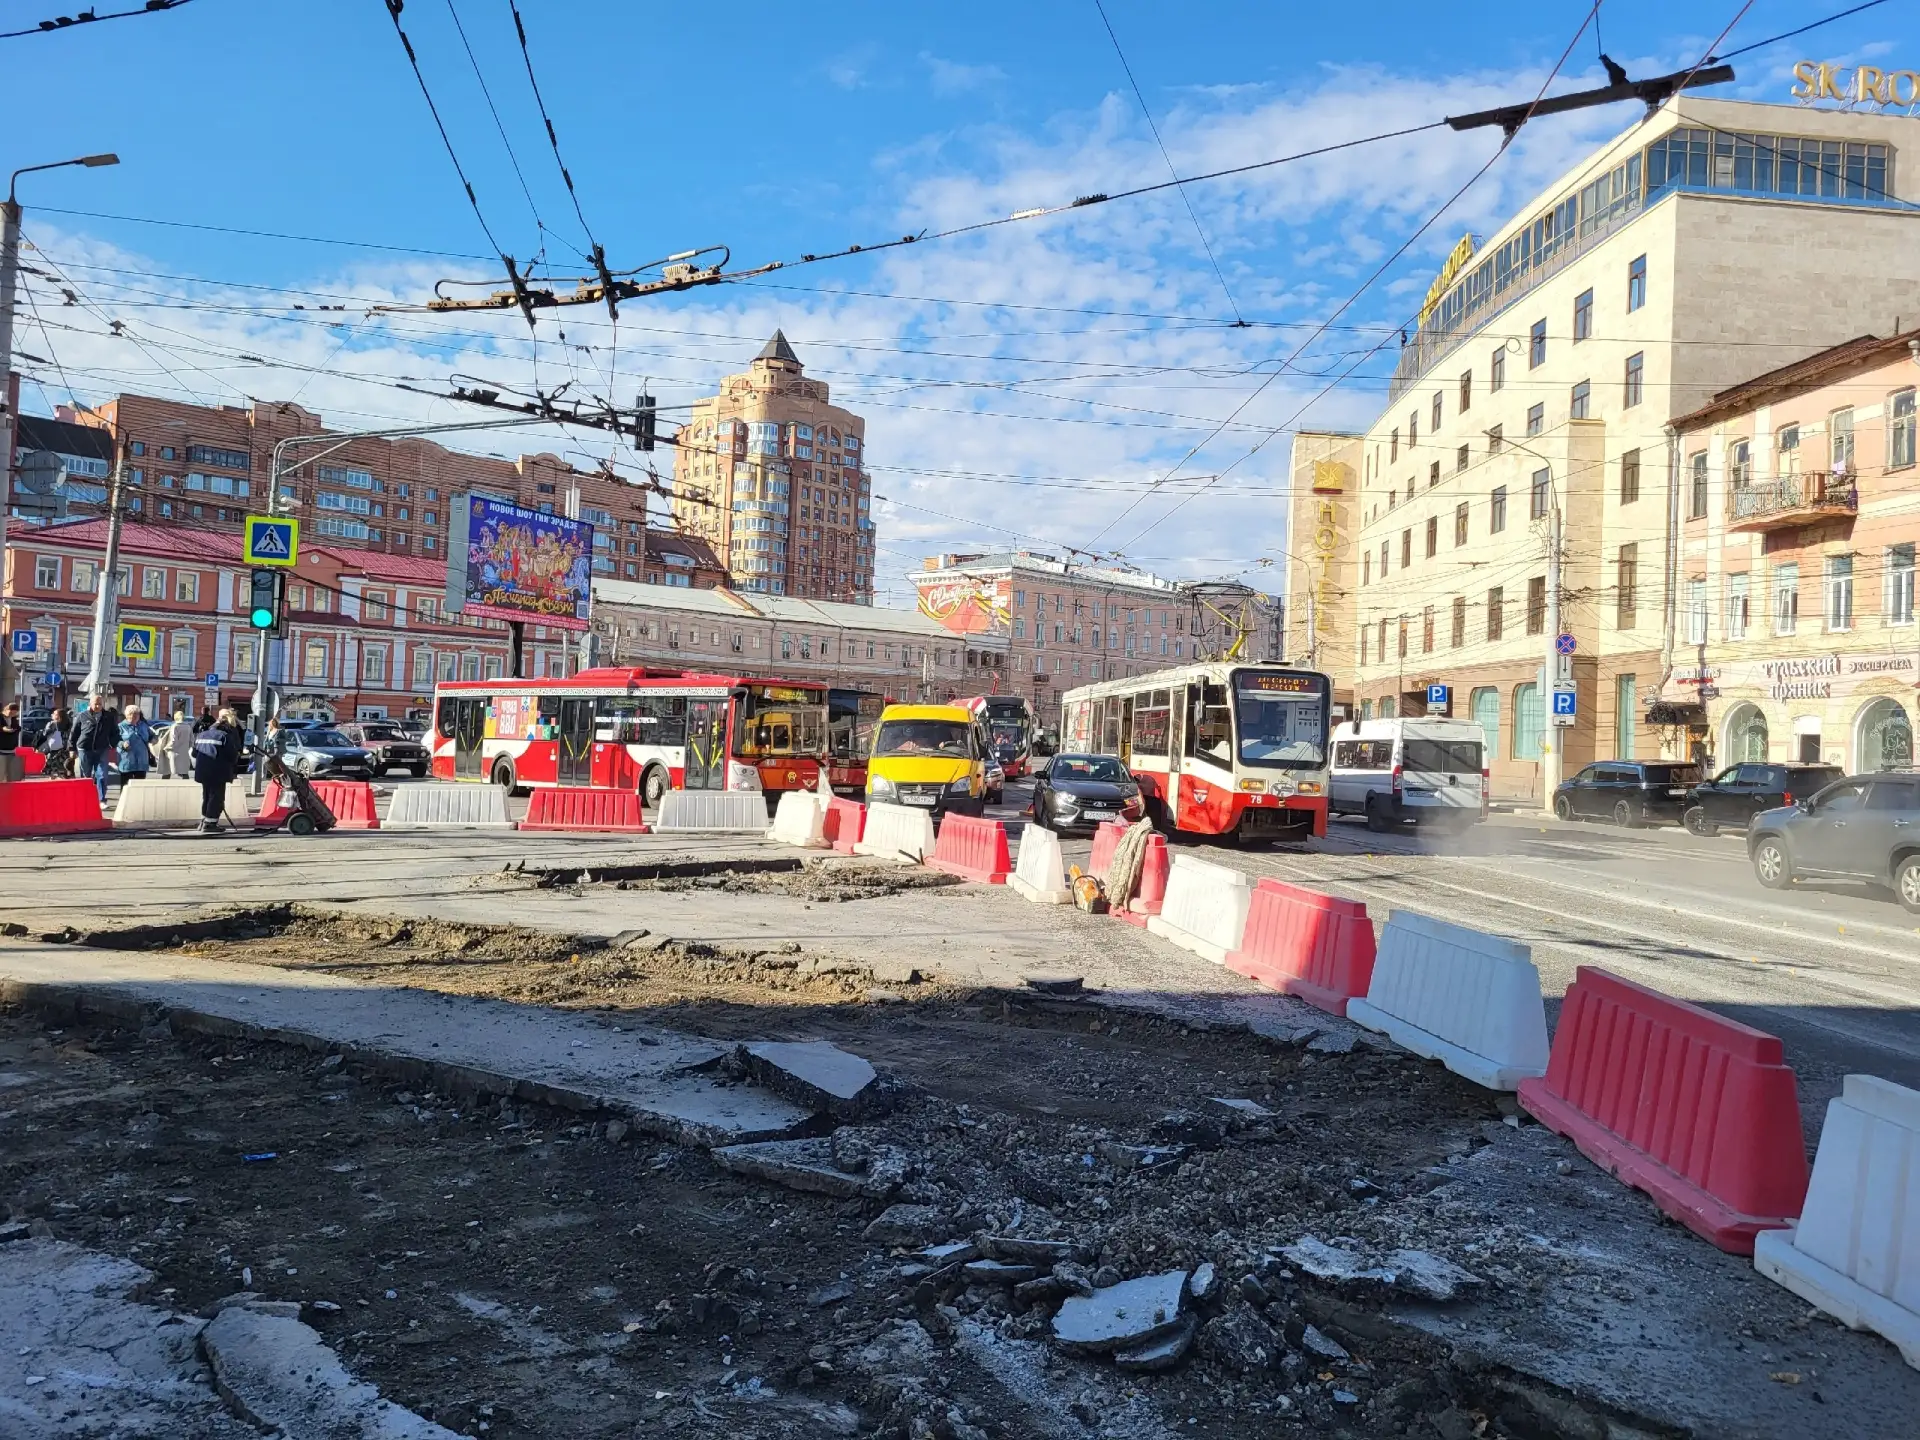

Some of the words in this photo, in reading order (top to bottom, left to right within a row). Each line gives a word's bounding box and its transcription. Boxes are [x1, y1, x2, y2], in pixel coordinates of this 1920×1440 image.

[1791, 60, 1845, 101] SK
[1442, 232, 1473, 287] HOTEL
[1319, 466, 1340, 482] SK
[489, 502, 515, 516] НОВОЕ
[516, 509, 533, 519] ШОУ
[1315, 501, 1338, 630] HOTEL
[499, 714, 516, 735] 880
[1250, 794, 1262, 804] 78
